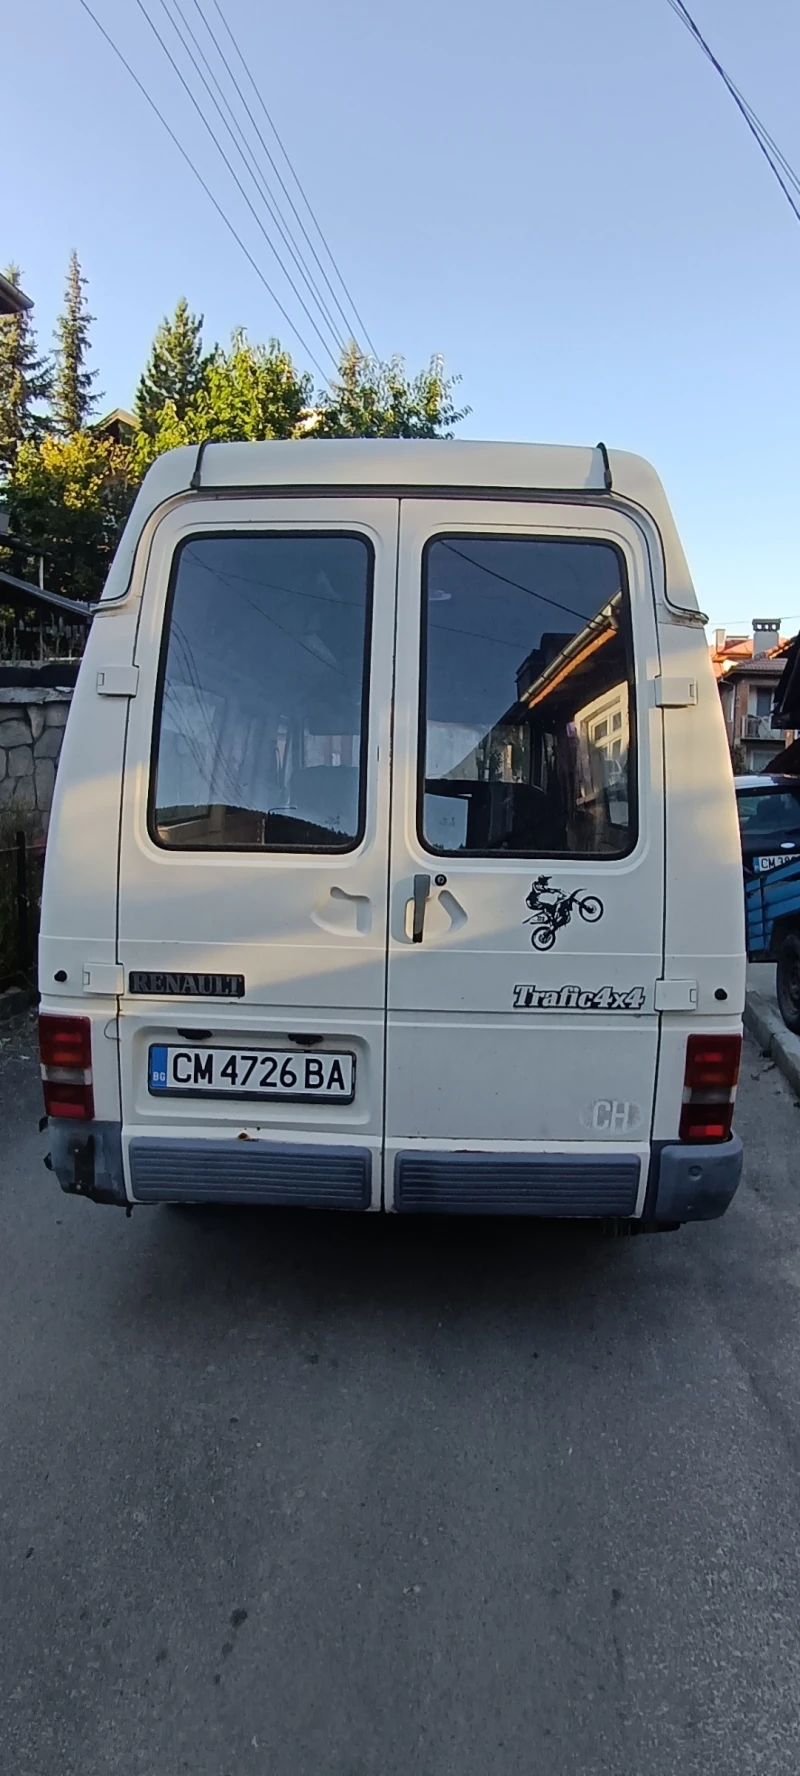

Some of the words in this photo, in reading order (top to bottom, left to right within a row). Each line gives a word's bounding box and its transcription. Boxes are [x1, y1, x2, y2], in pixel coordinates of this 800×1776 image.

[131, 973, 242, 995] RENAULT
[152, 1071, 166, 1082] BG
[172, 1052, 214, 1085] CM
[220, 1055, 297, 1088] 4726
[304, 1057, 345, 1091] BA
[592, 1100, 630, 1132] CH
